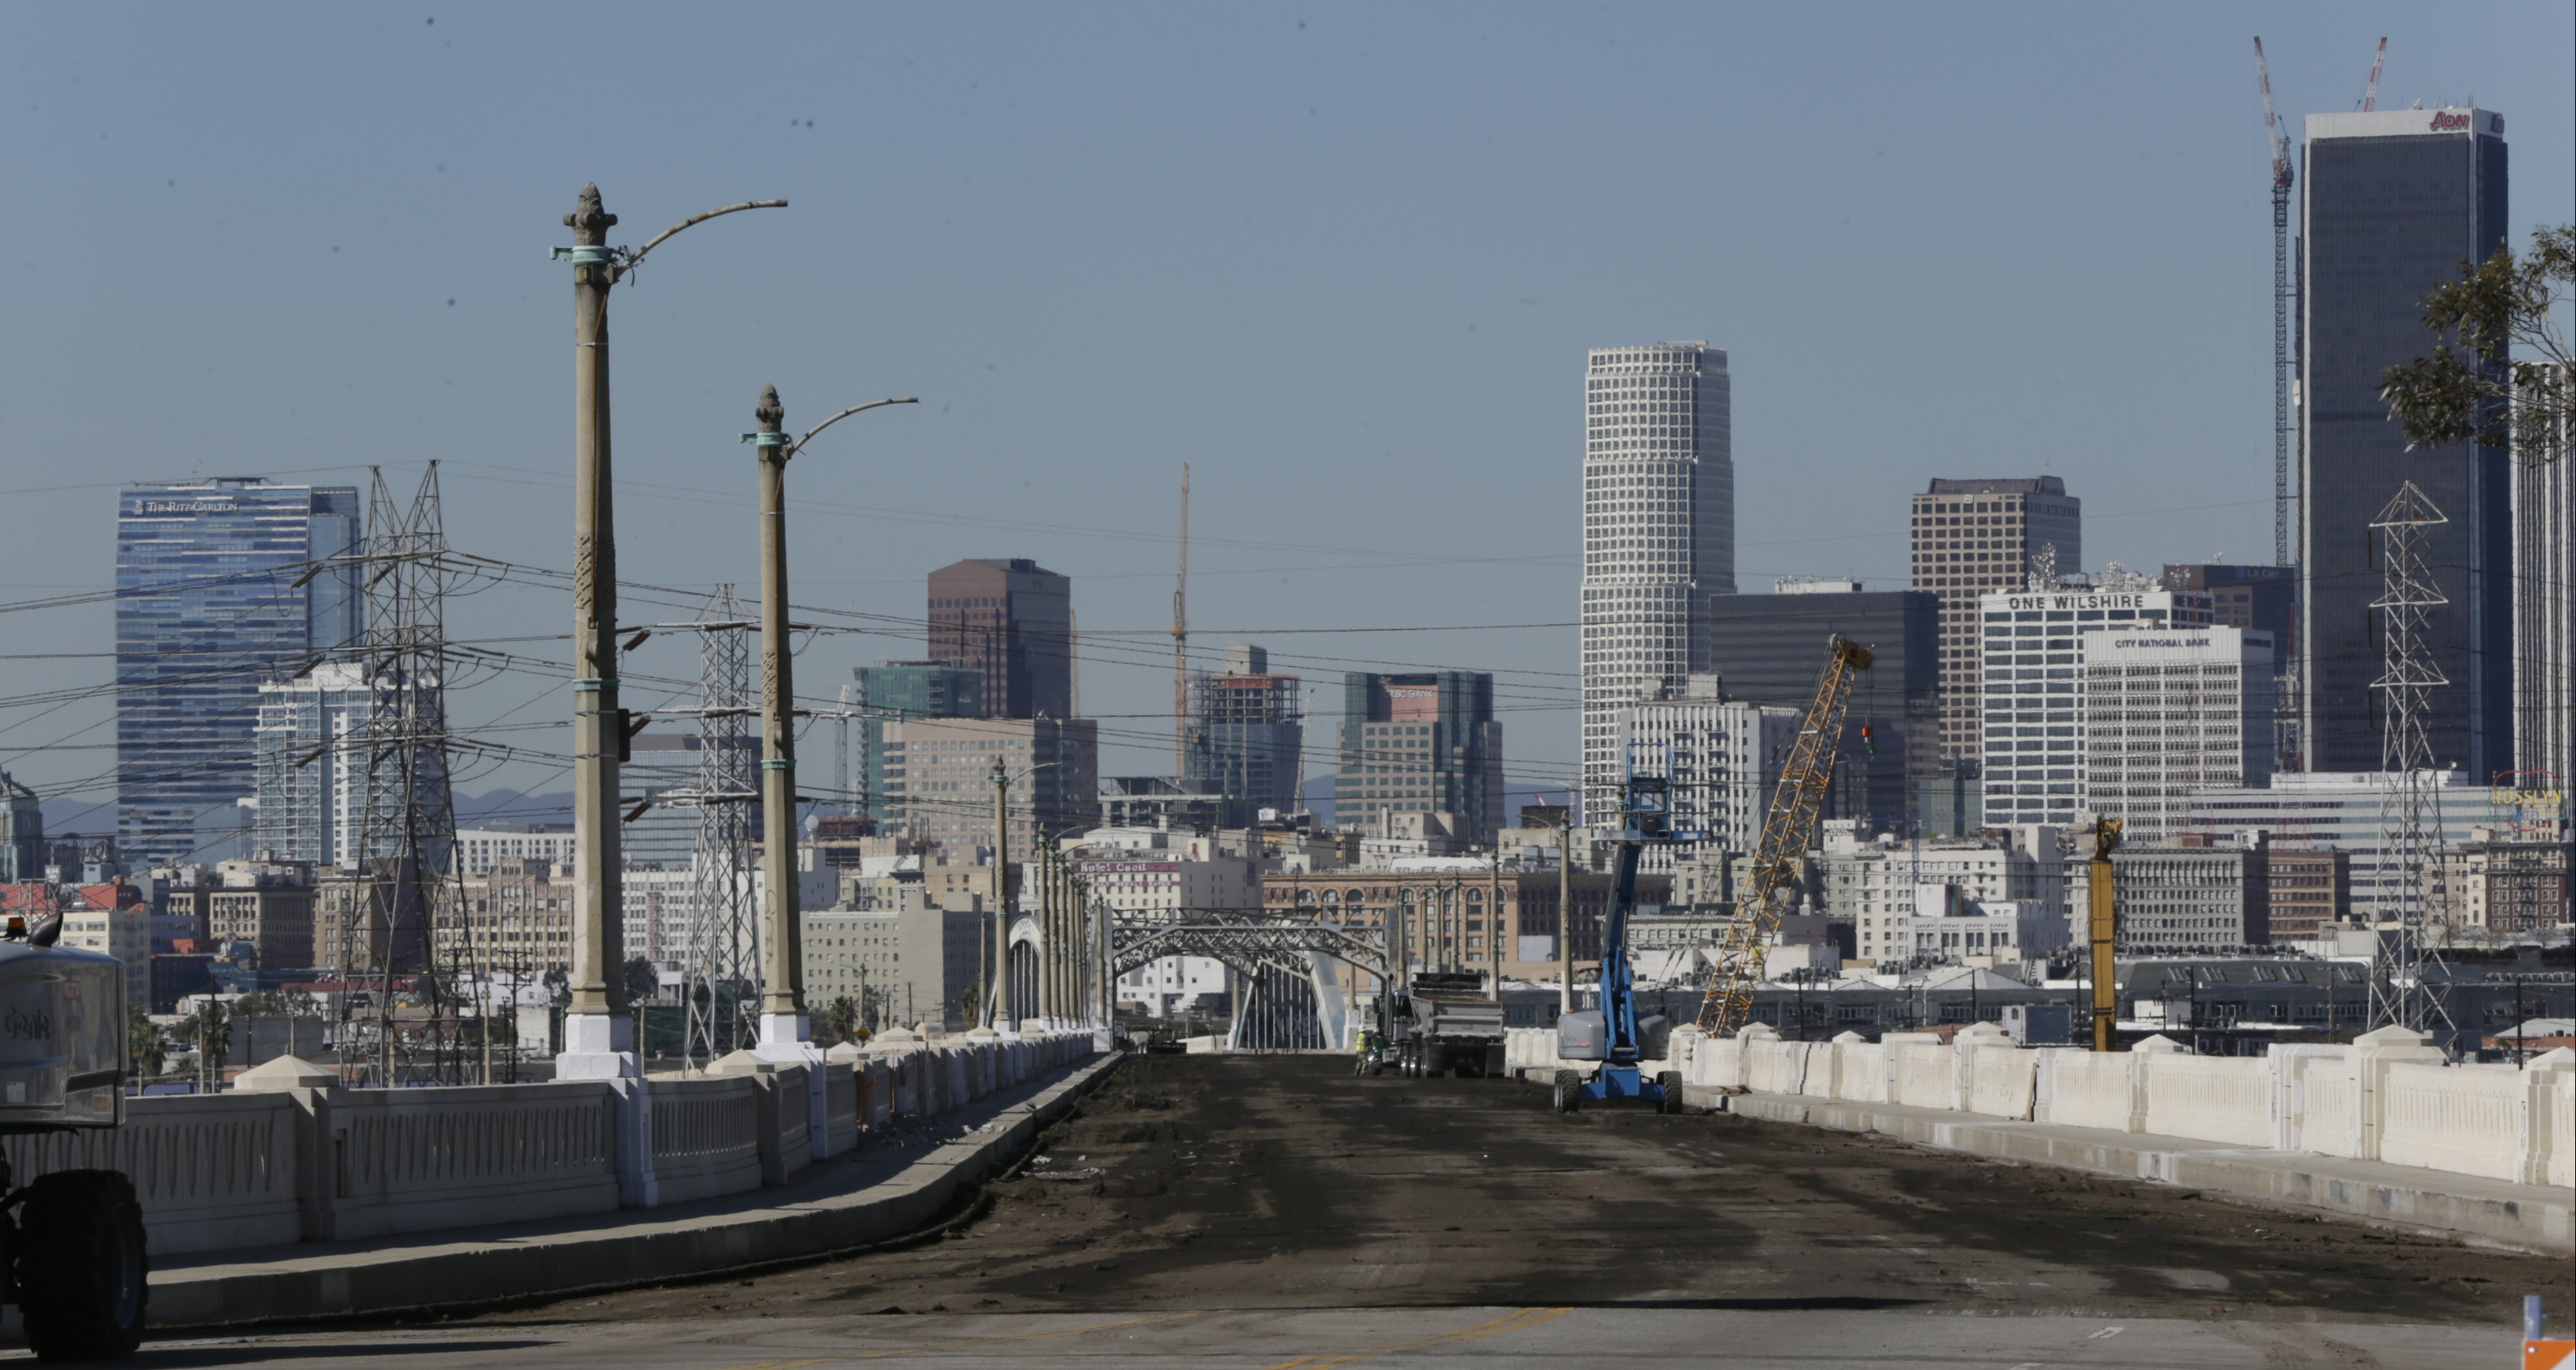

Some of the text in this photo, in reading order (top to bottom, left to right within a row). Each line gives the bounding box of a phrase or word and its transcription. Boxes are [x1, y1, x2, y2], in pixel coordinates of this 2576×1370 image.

[147, 501, 167, 512] THE
[2009, 595, 2144, 609] ONE WILSHIRE
[2115, 638, 2211, 649] CITY NATIONAL BANK
[1408, 689, 1434, 699] BANK
[2492, 790, 2562, 804] ROSSLYN
[1080, 863, 1146, 872] Hotel Cecil
